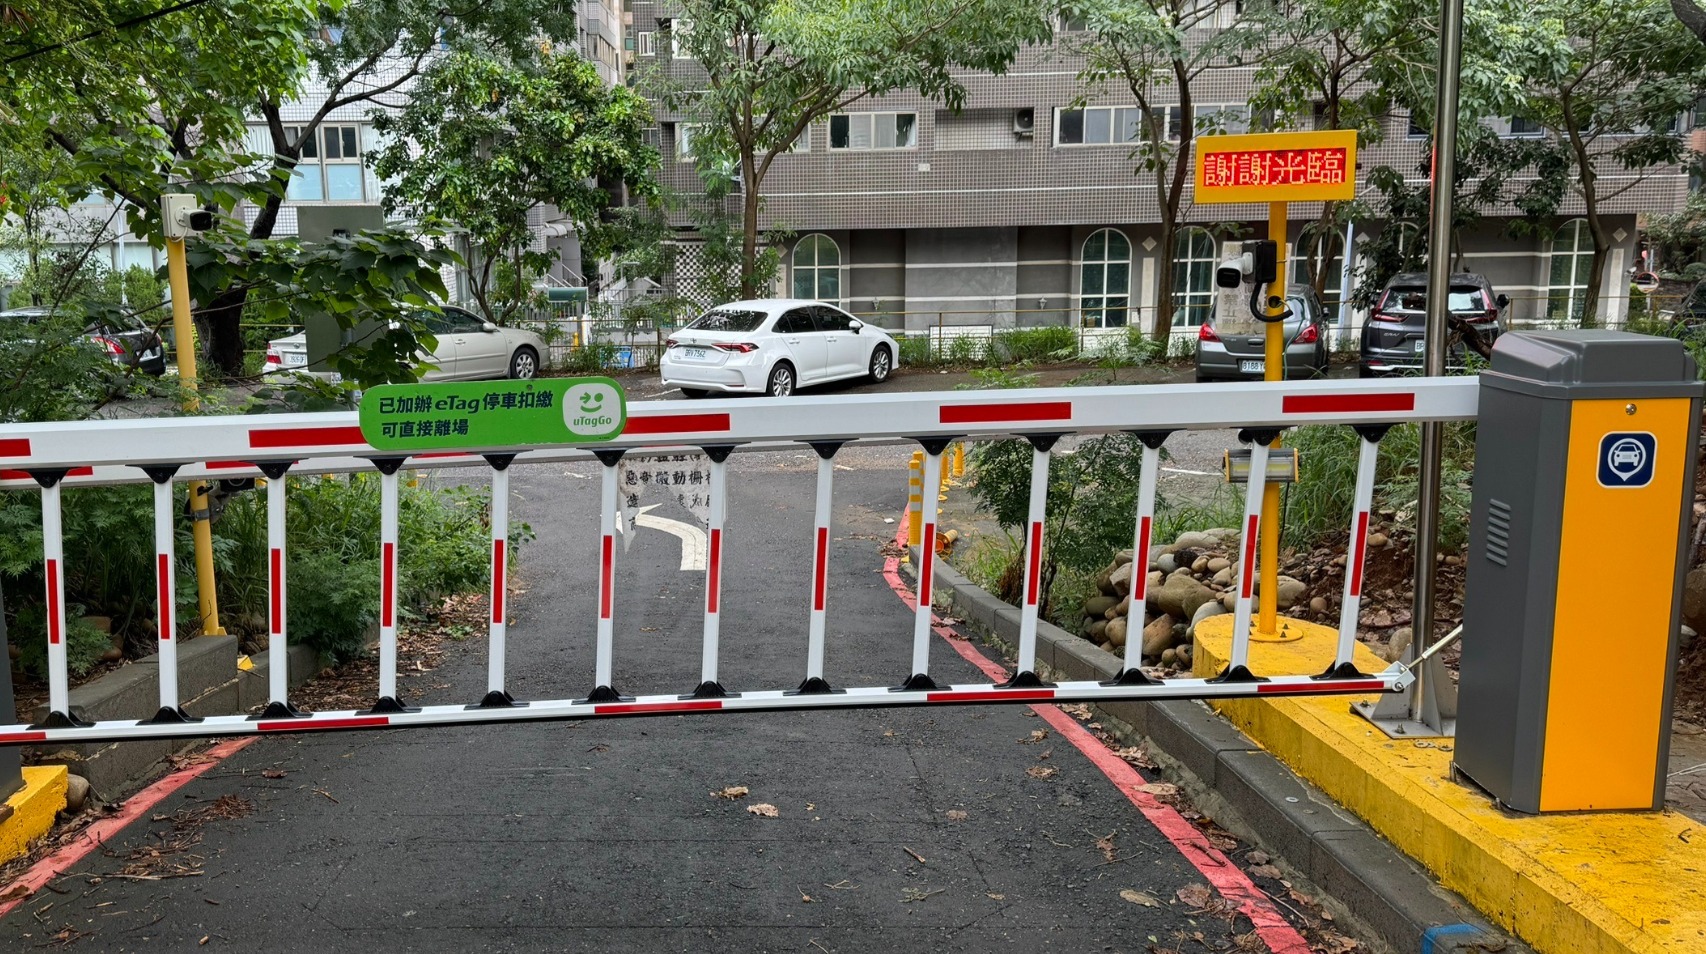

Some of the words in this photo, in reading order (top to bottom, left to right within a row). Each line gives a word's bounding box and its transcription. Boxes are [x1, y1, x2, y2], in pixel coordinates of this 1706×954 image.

[1204, 151, 1342, 186] 謝謝光臨
[379, 394, 432, 414] 已加辦
[435, 395, 480, 415] eTag
[482, 390, 554, 410] 停車扣繳
[381, 418, 469, 439] 可直接離場
[573, 415, 612, 428] uTagGo
